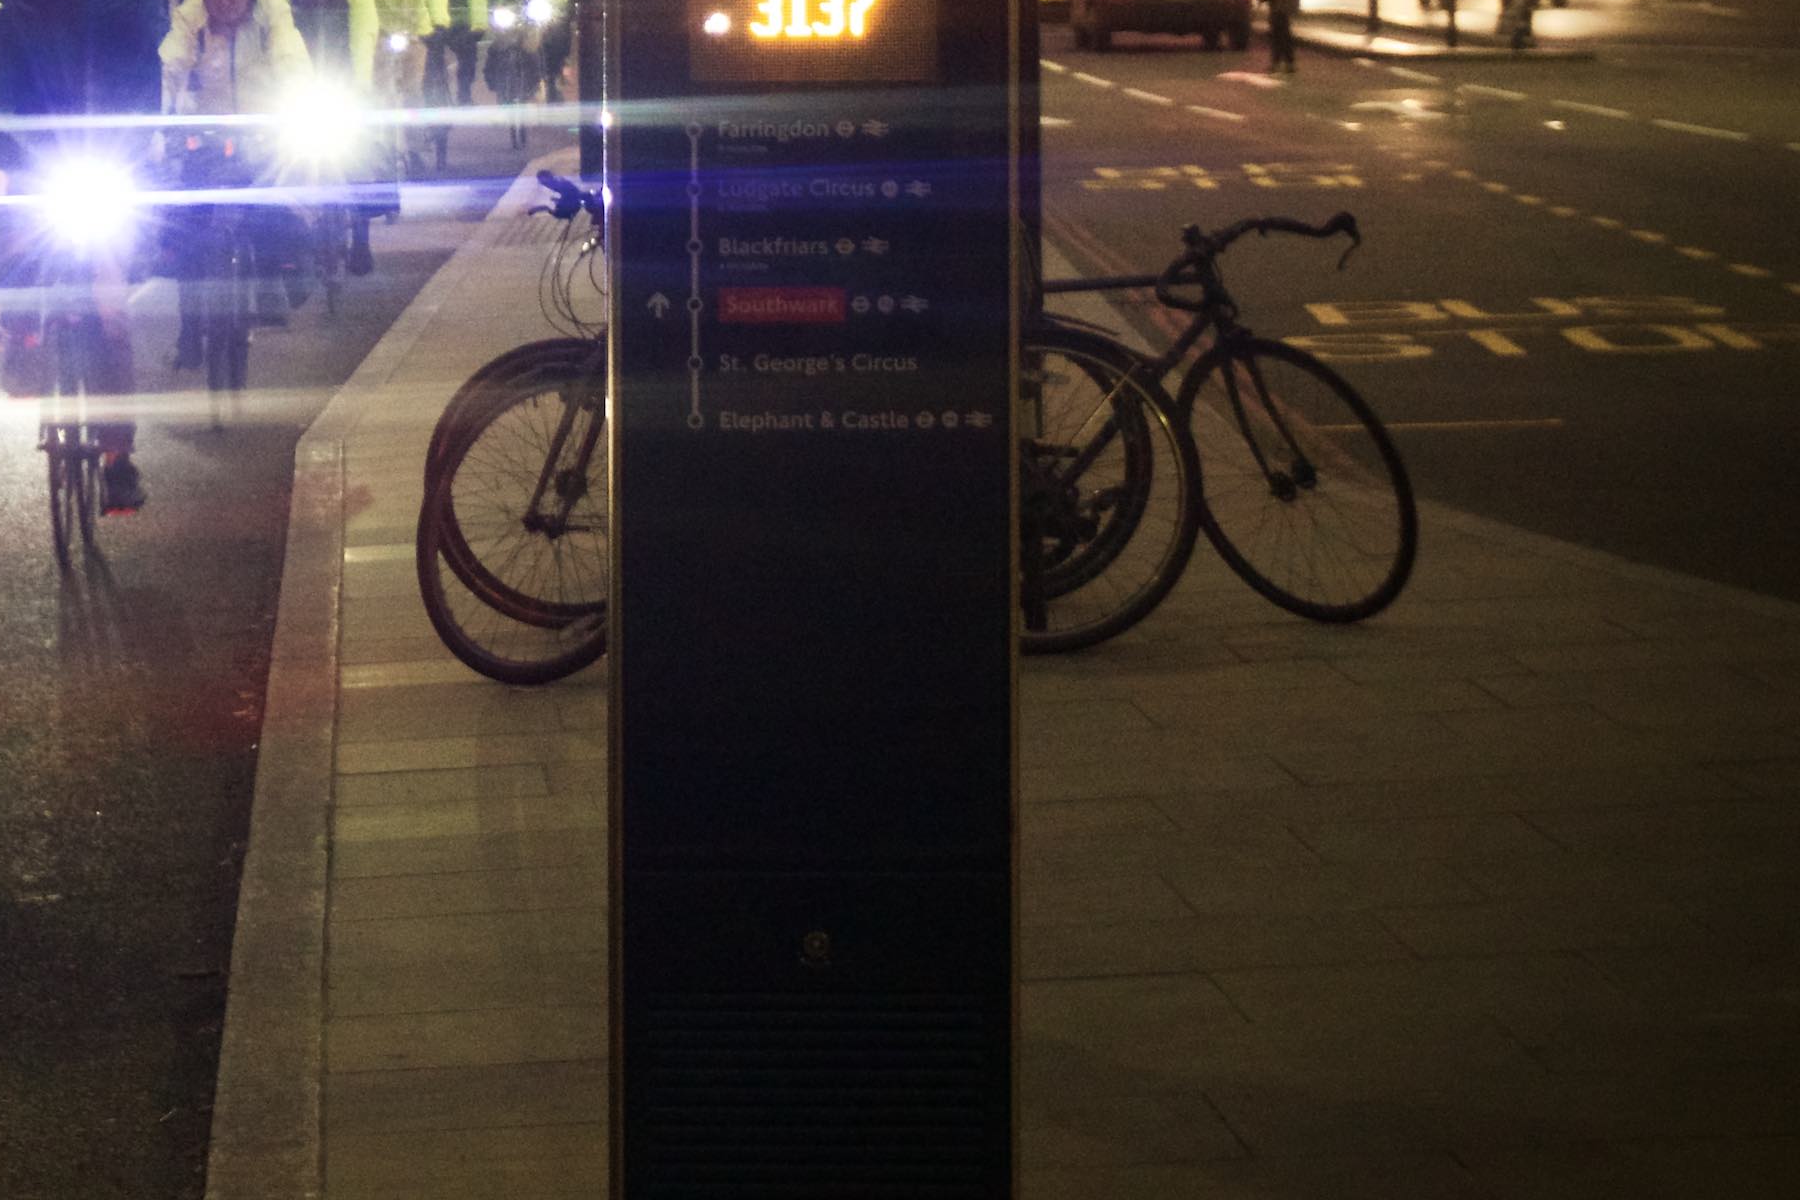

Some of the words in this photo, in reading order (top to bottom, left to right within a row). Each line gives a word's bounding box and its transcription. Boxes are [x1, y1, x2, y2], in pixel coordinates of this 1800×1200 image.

[718, 120, 830, 142] Farringdon
[718, 178, 802, 202] Ludgate
[809, 178, 875, 198] Circus
[718, 237, 829, 255] Blackfriars
[726, 297, 839, 315] Southwark
[719, 355, 747, 371] St.
[753, 353, 846, 376] George's
[852, 353, 918, 372] Circus
[718, 410, 813, 433] Elephant
[821, 411, 835, 429] &
[841, 410, 909, 429] Castle
